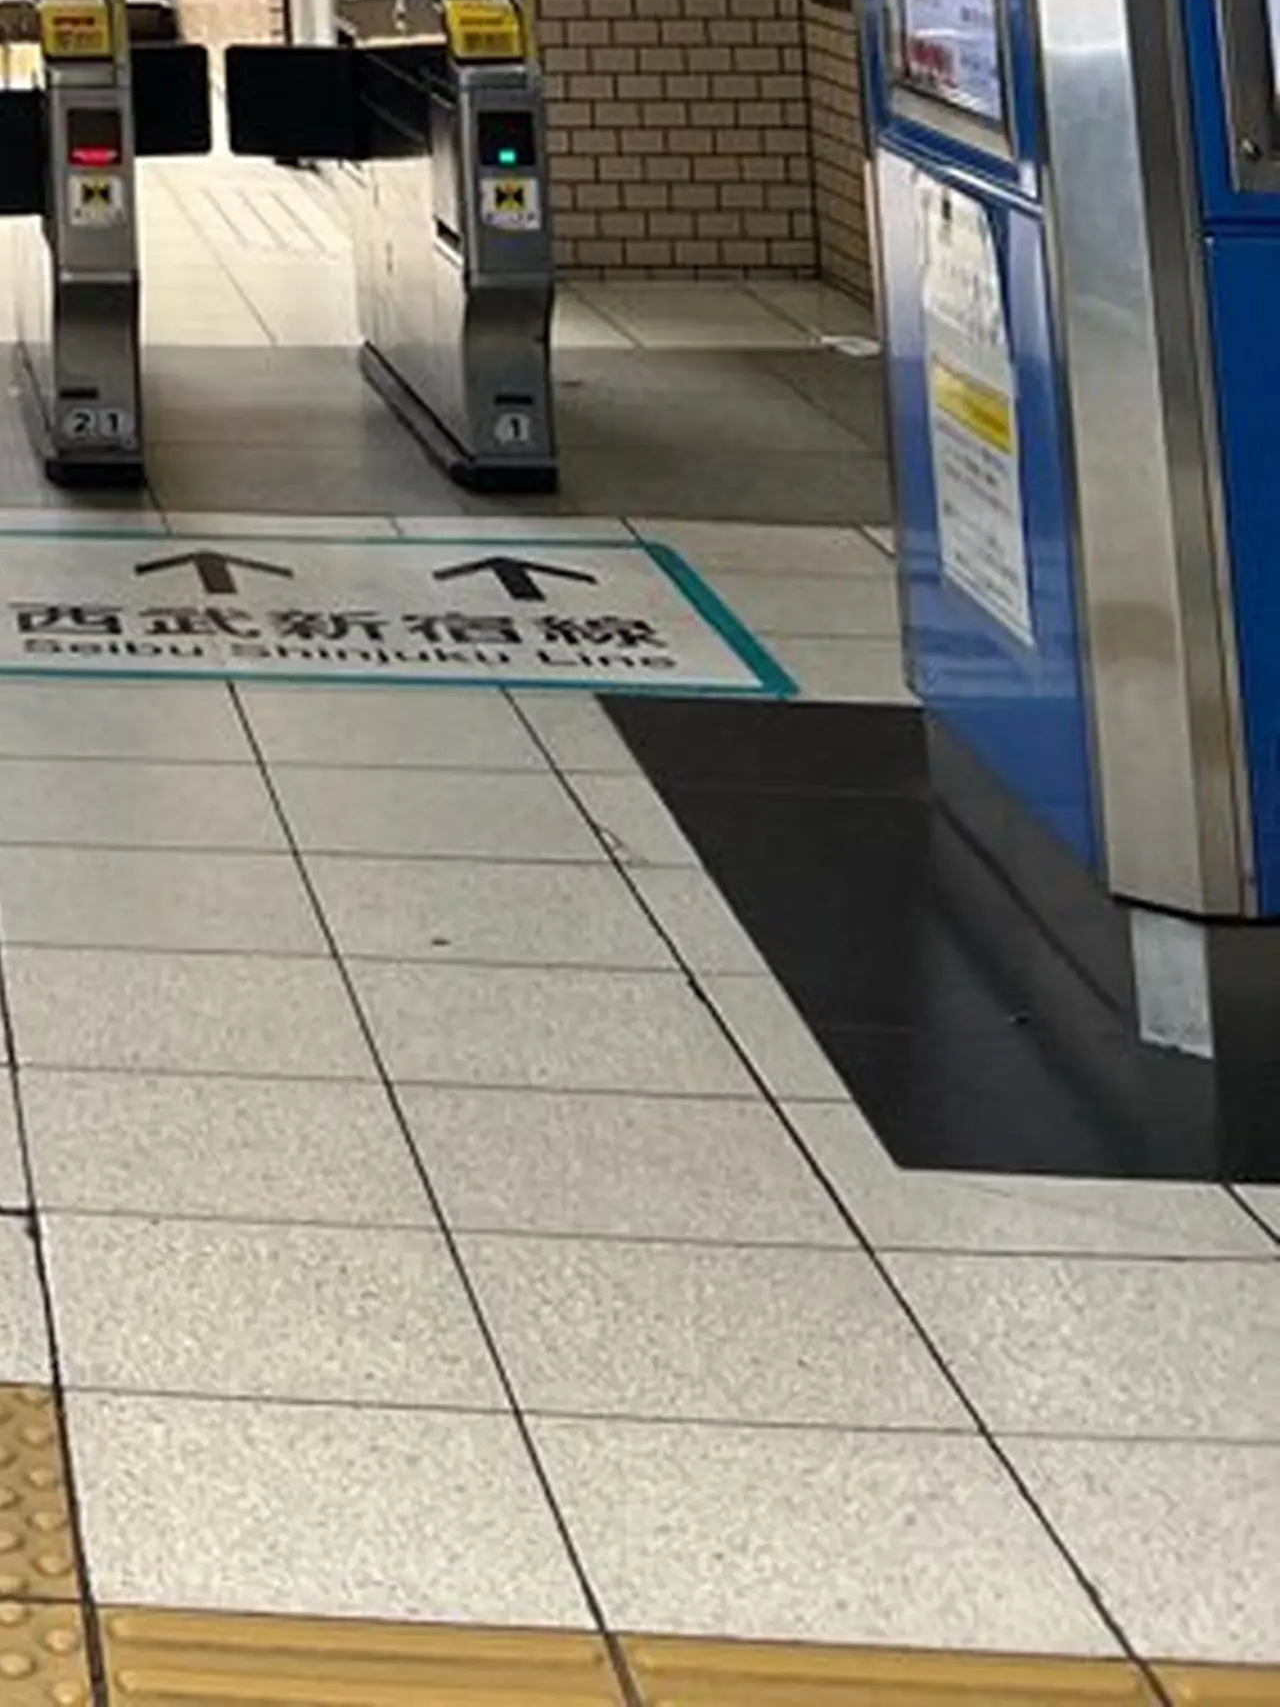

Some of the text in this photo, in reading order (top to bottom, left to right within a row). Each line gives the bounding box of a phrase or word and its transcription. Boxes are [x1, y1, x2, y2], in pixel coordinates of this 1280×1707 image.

[73, 411, 92, 435] 2
[106, 411, 122, 434] 1
[508, 416, 523, 440] 1
[8, 597, 671, 653] 西武新宿線
[20, 636, 678, 672] Seibu Shinjuku Line
